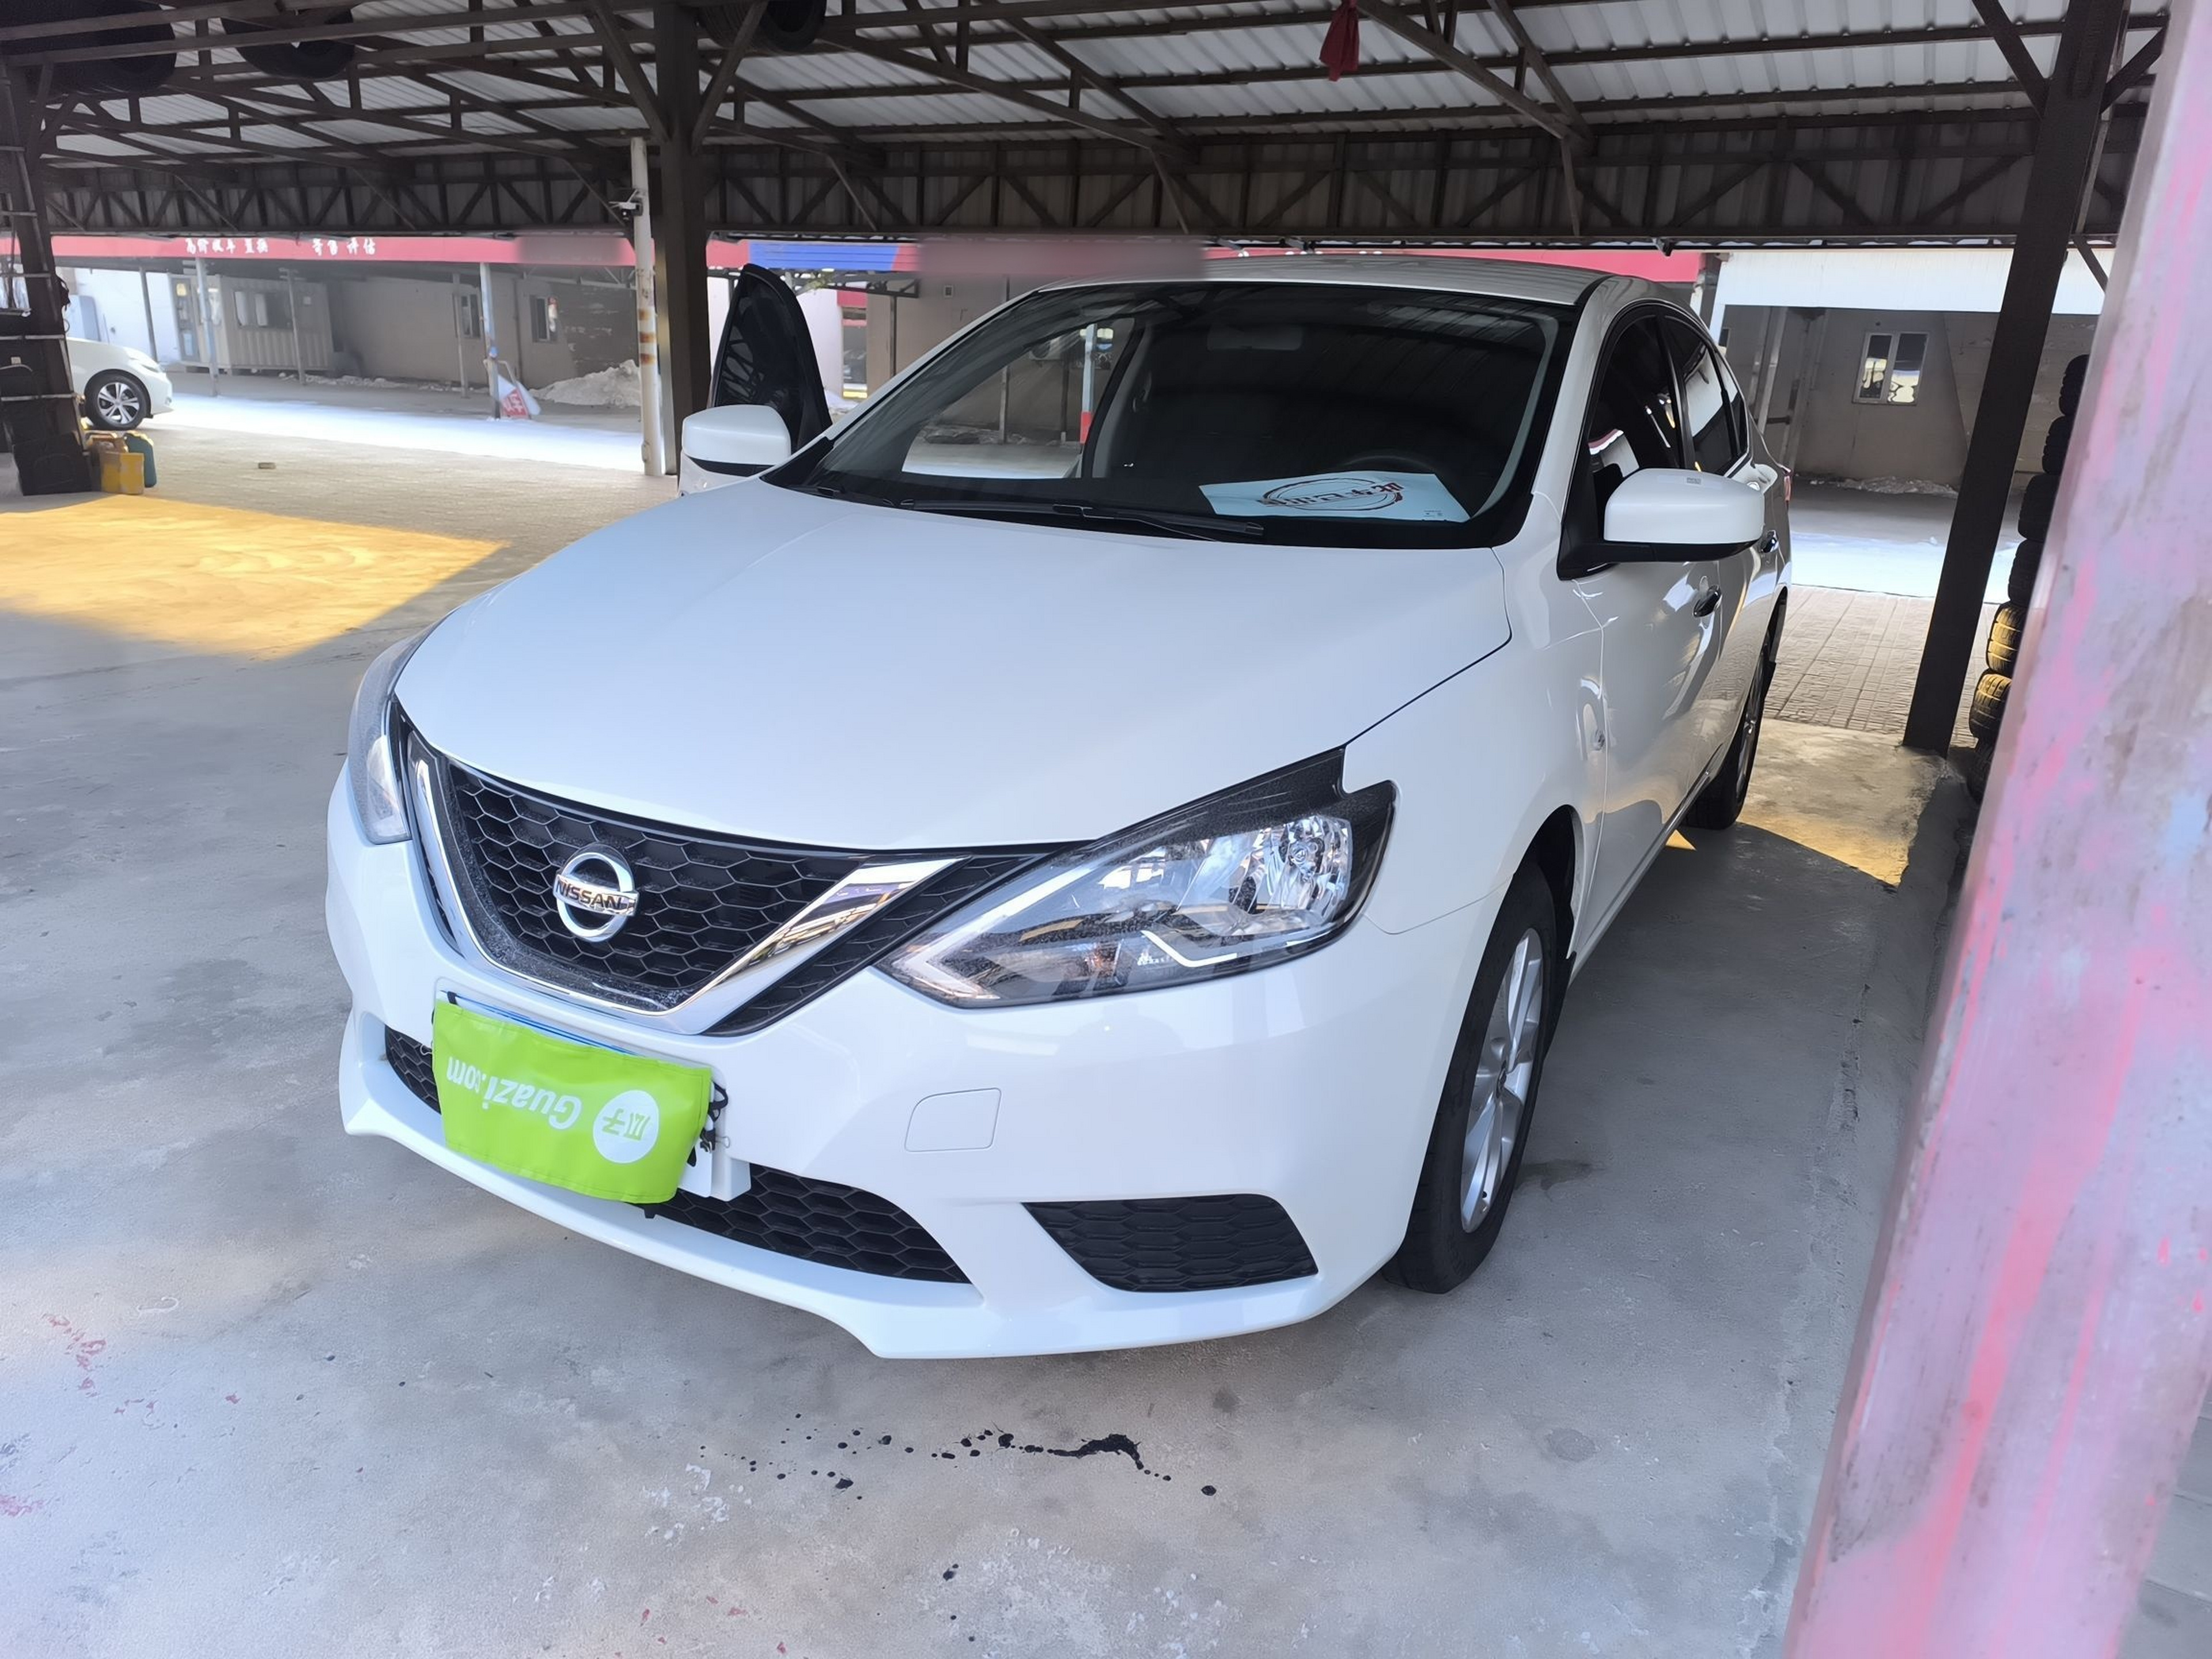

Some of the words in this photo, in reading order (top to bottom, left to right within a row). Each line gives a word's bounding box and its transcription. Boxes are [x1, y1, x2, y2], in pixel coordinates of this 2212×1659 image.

[555, 880, 622, 910] NISSAN
[445, 1055, 583, 1130] Guazi.com
[601, 1107, 651, 1142] 瓜子
